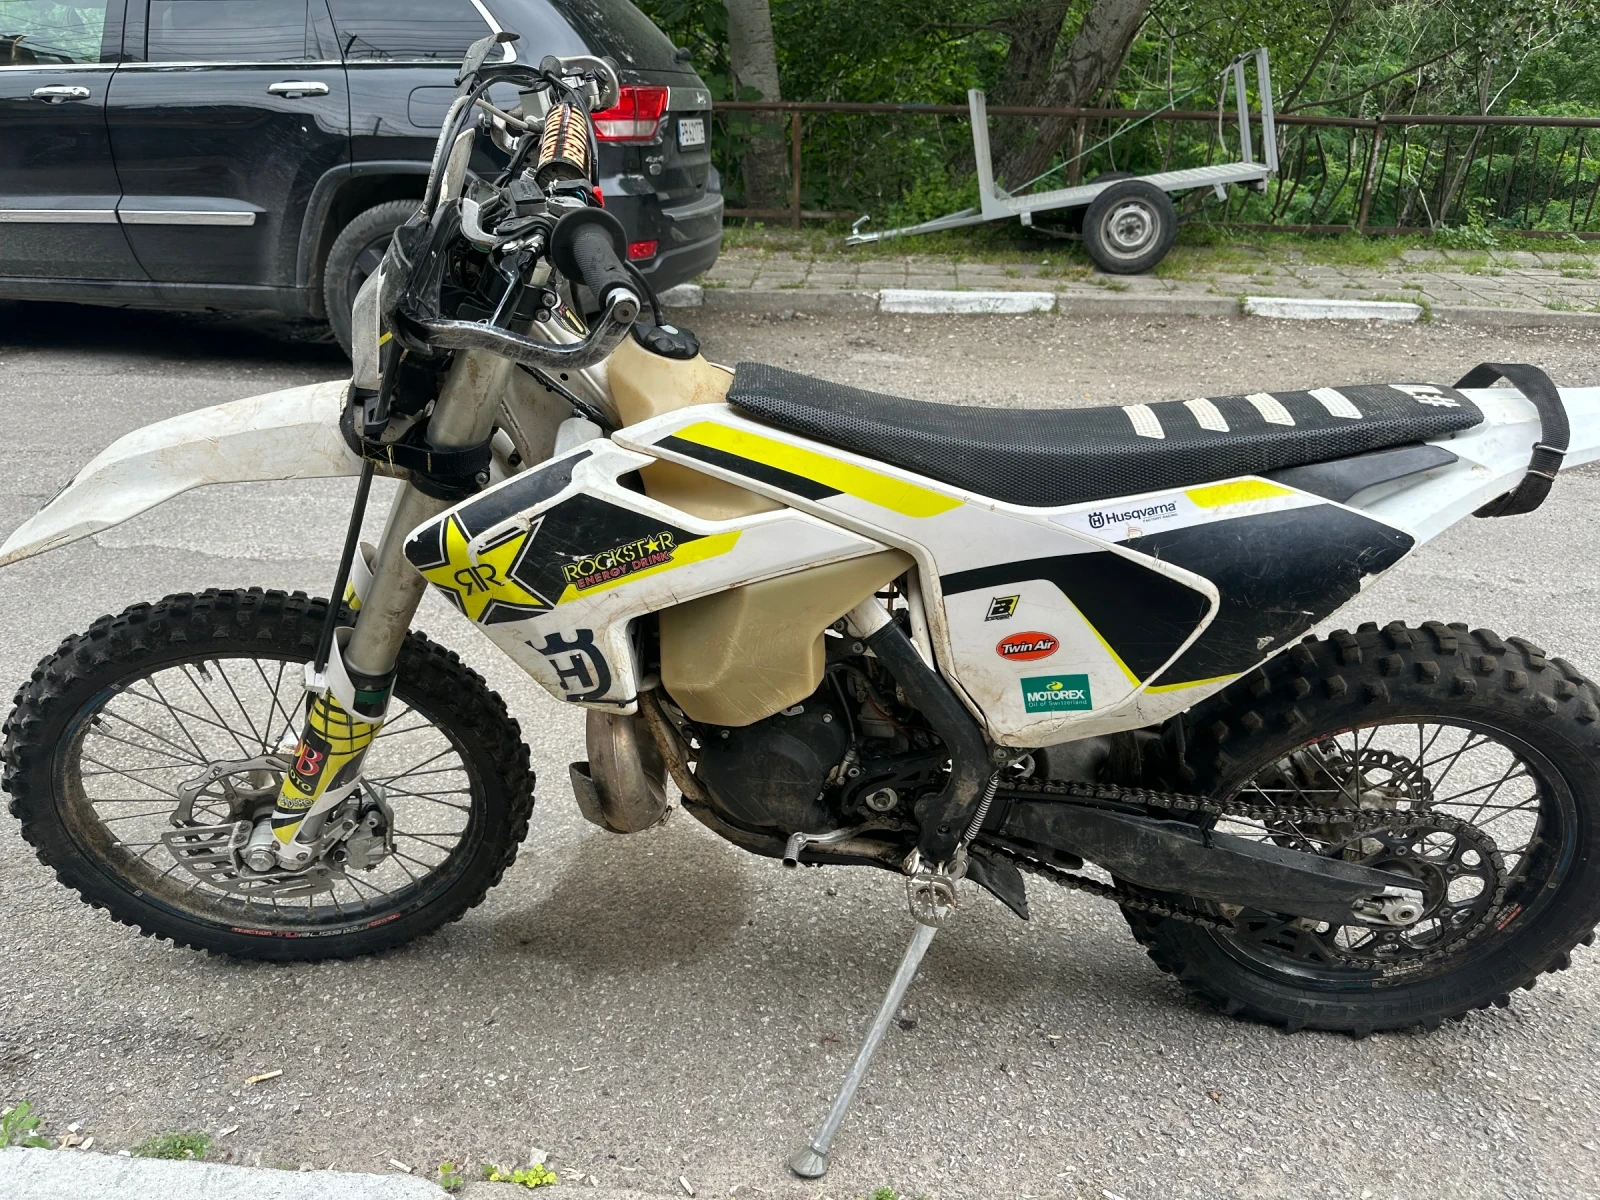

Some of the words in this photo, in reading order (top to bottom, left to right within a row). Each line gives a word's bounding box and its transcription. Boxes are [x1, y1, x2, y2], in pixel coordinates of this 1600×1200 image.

[1106, 502, 1177, 524] Husqvarna
[577, 564, 627, 588] ENERGY
[631, 550, 670, 571] DRINK
[1002, 642, 1033, 654] Twin
[1033, 639, 1055, 650] Air
[1026, 689, 1086, 702] MOTOREX
[1048, 699, 1088, 707] Switzerland
